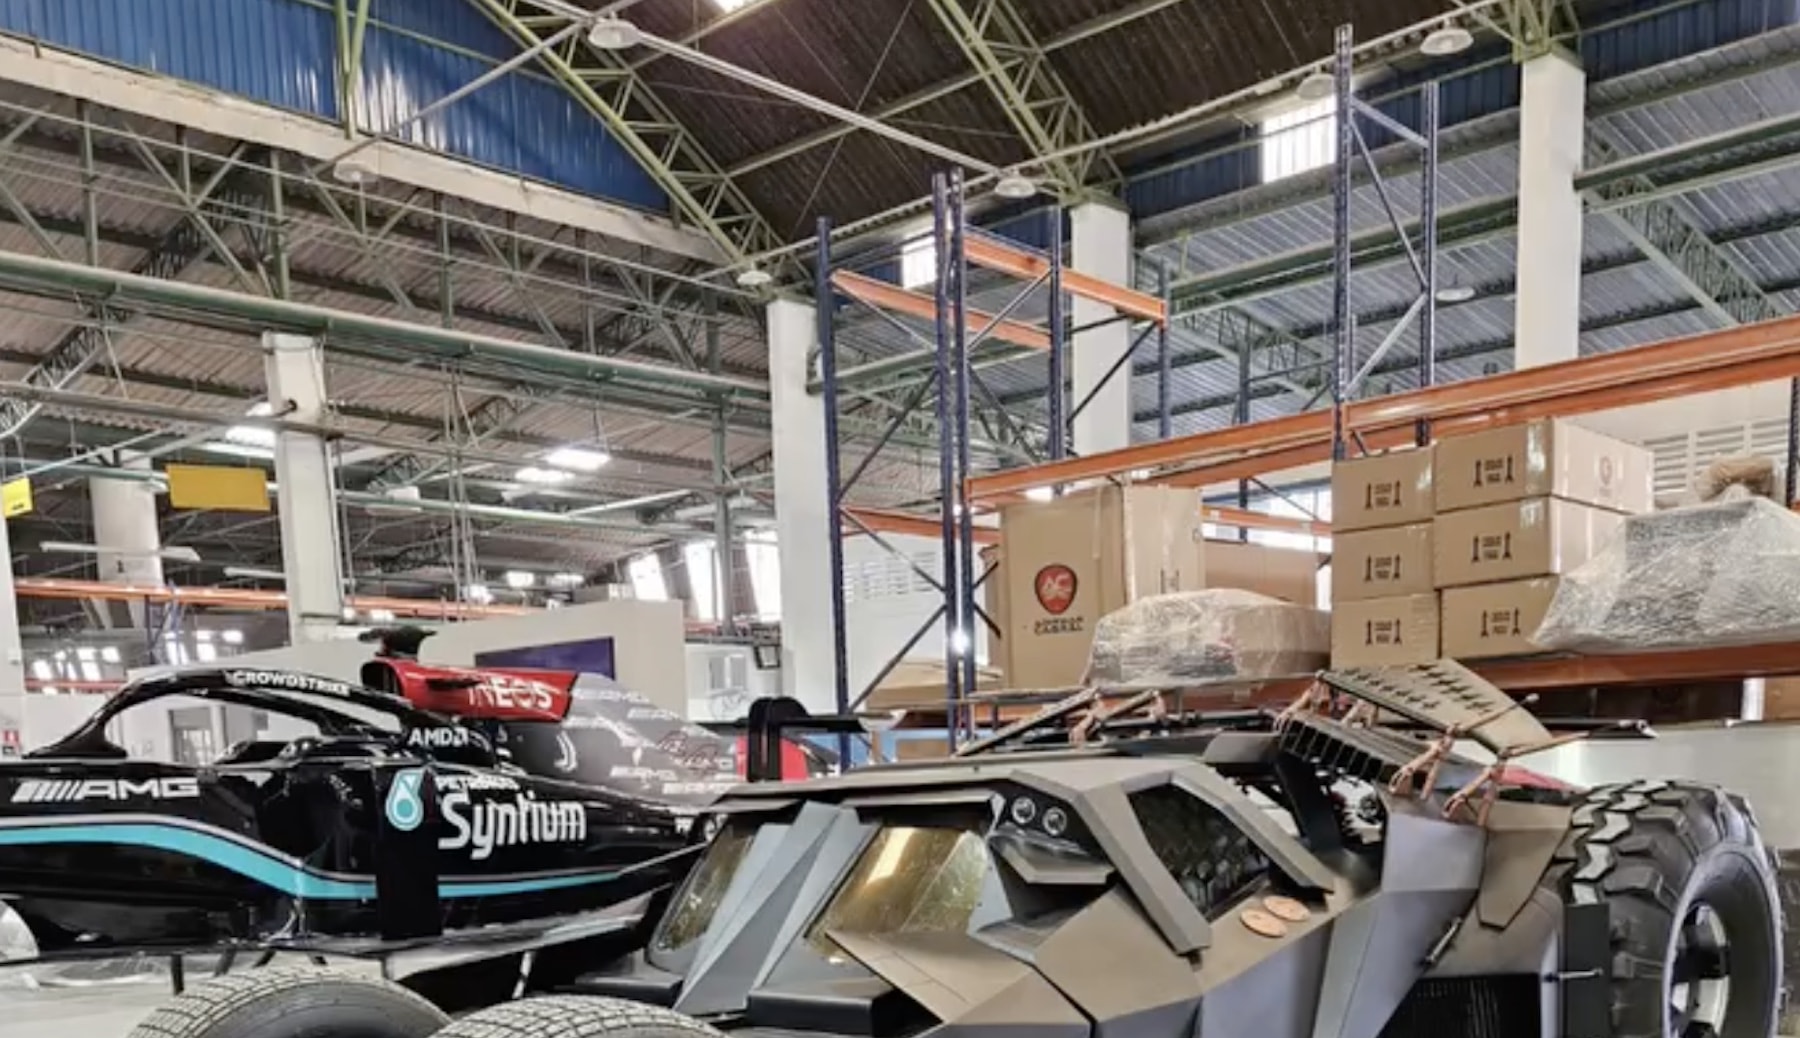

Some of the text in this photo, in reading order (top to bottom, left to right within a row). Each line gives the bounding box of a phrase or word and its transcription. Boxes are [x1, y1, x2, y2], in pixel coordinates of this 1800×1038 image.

[229, 671, 351, 697] CROWDSTRIKE
[467, 676, 553, 709] INEOS
[76, 777, 201, 801] AMG
[437, 790, 587, 860] Syntium
